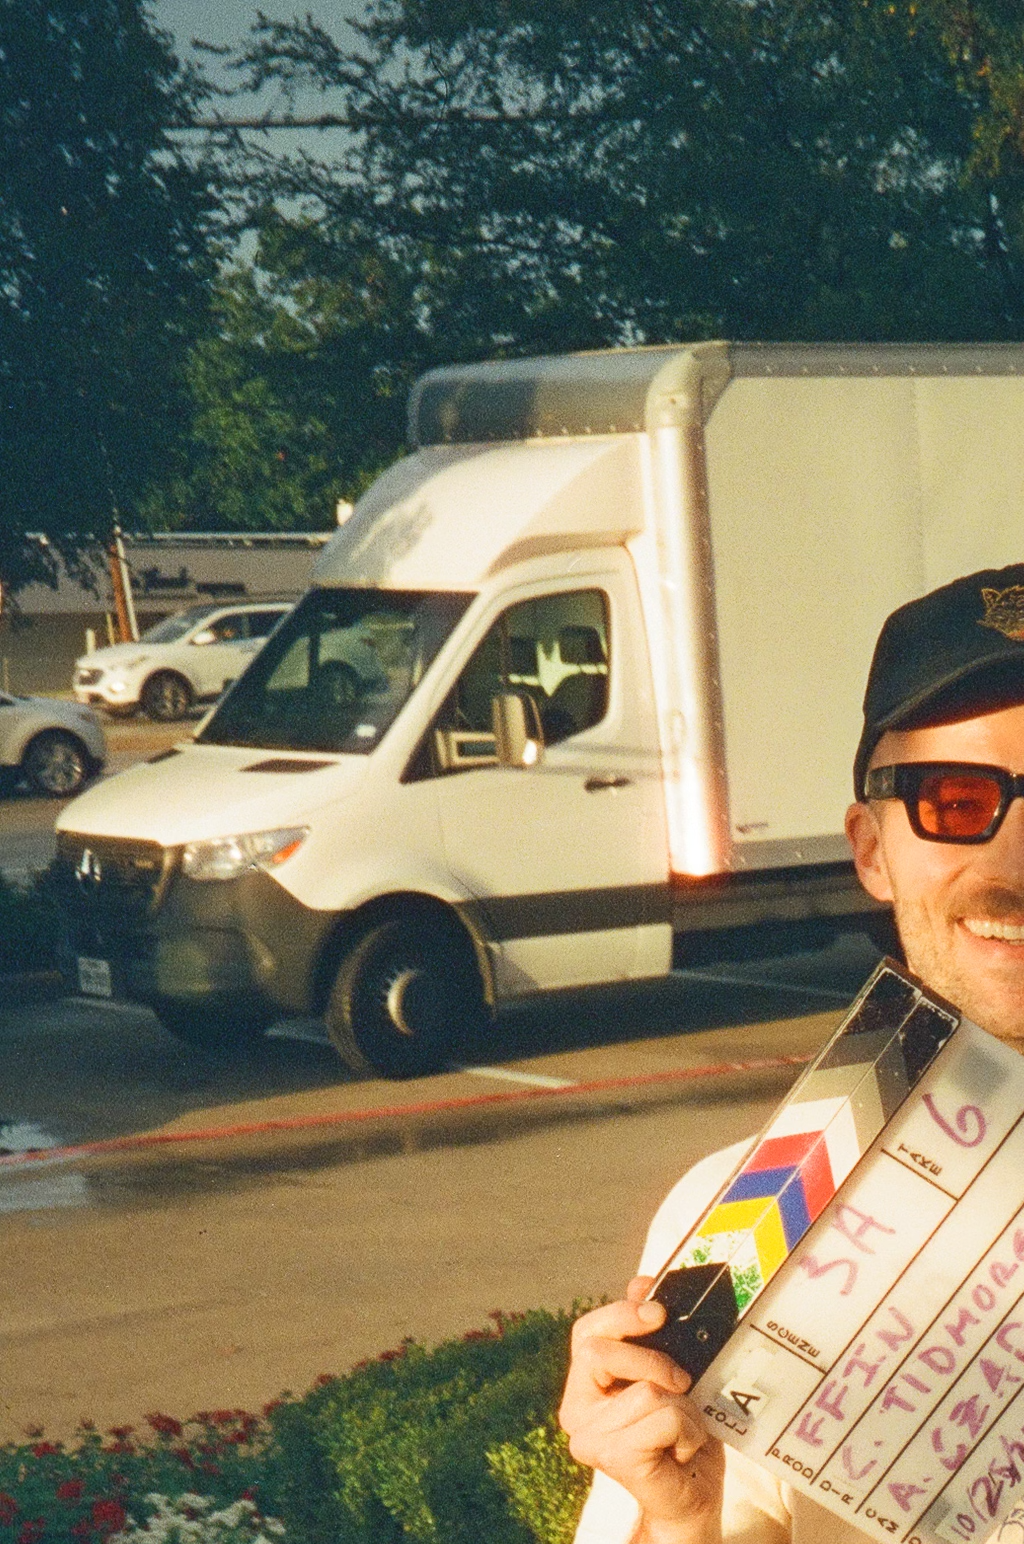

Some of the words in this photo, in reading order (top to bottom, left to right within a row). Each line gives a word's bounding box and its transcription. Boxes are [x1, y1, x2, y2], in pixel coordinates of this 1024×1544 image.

[921, 1092, 987, 1149] 6
[897, 1143, 943, 1177] TAKE
[800, 1202, 896, 1296] 3A
[766, 1319, 821, 1359] SCENE
[794, 1306, 915, 1448] FFIN
[730, 1390, 761, 1416] A
[703, 1404, 748, 1437] ROLL
[771, 1447, 815, 1480] PROD
[819, 1479, 855, 1506] DIR
[865, 1507, 900, 1535] CAM
